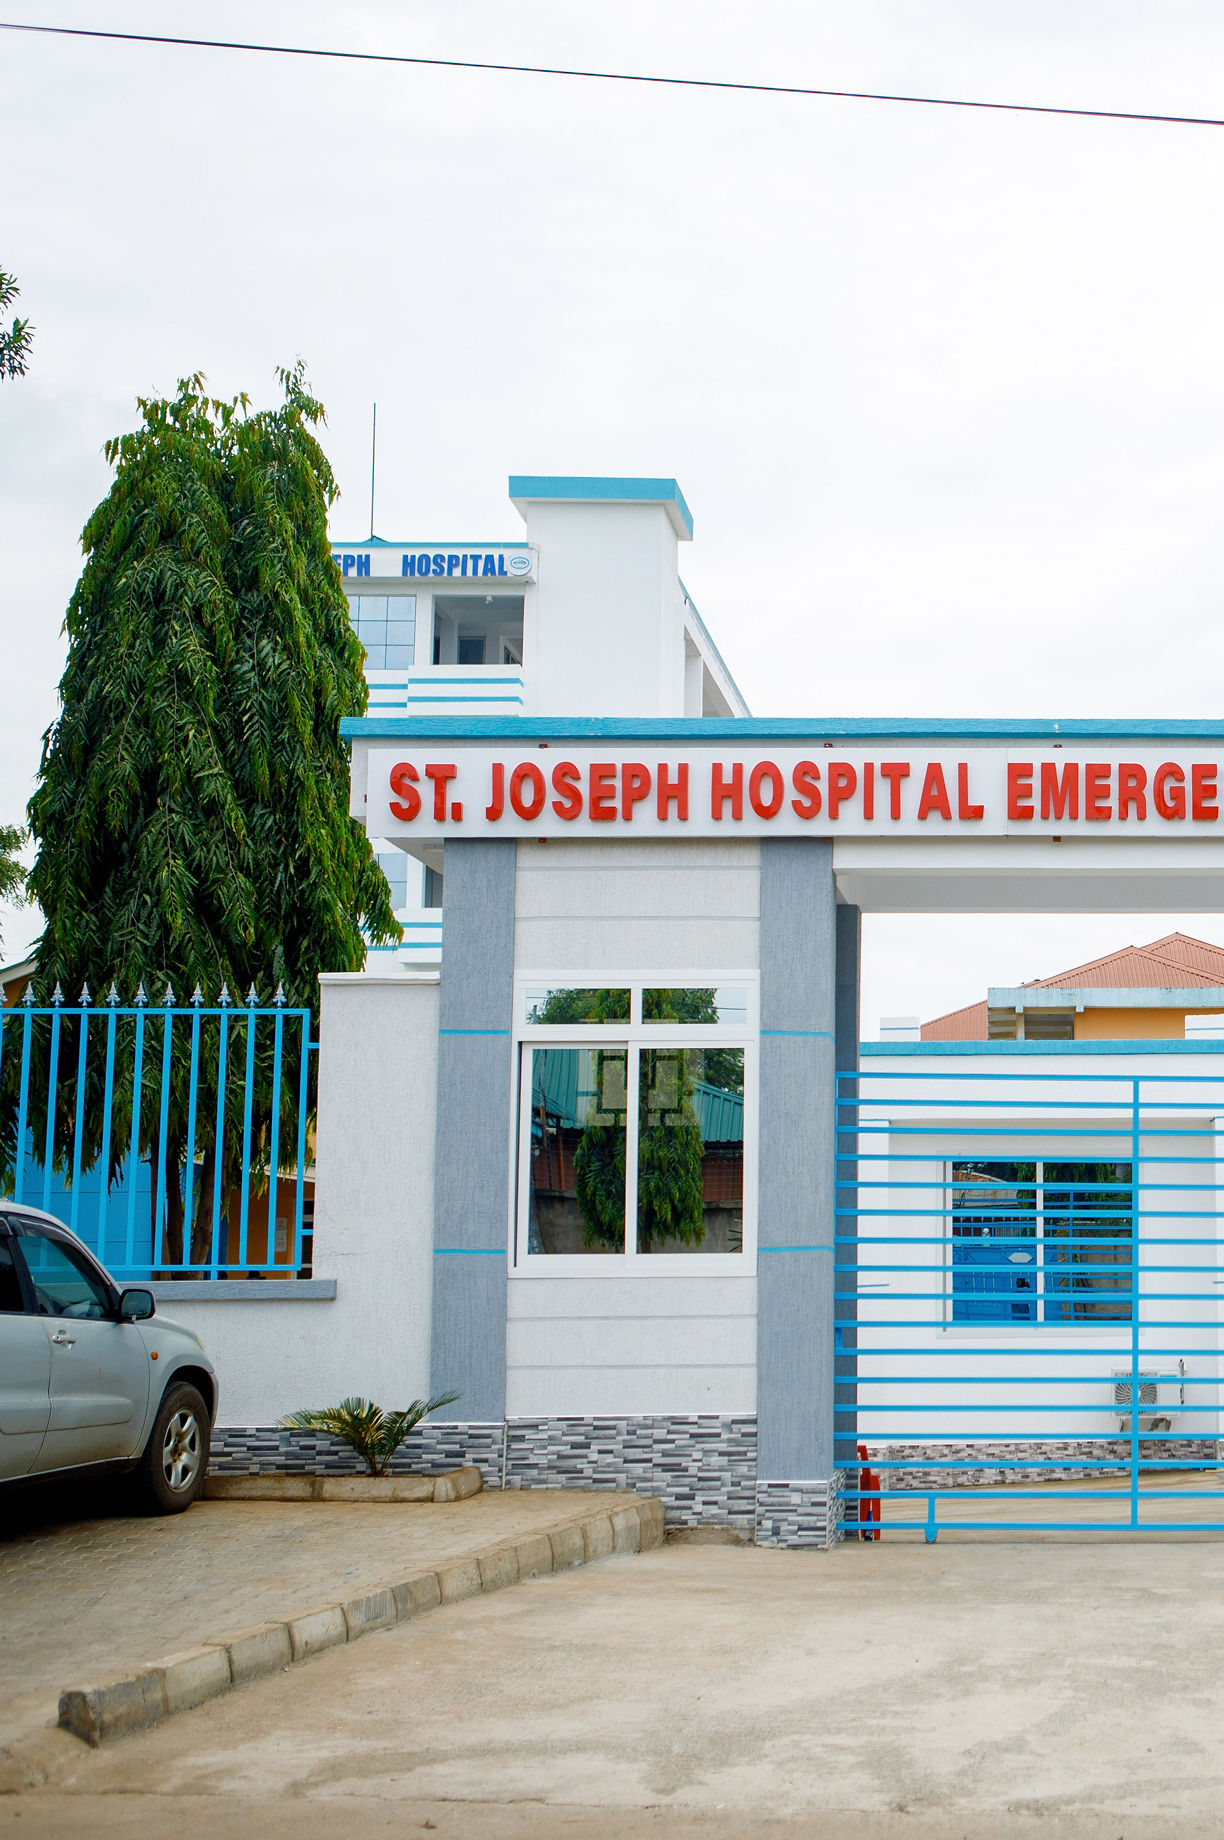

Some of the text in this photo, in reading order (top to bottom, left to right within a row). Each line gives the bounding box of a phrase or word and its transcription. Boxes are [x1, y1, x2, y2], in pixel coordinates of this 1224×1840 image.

[402, 553, 508, 577] HOSPITAL
[389, 762, 463, 821] ST.
[485, 761, 689, 821] JOSEPH
[711, 760, 985, 820] HOSPITAL
